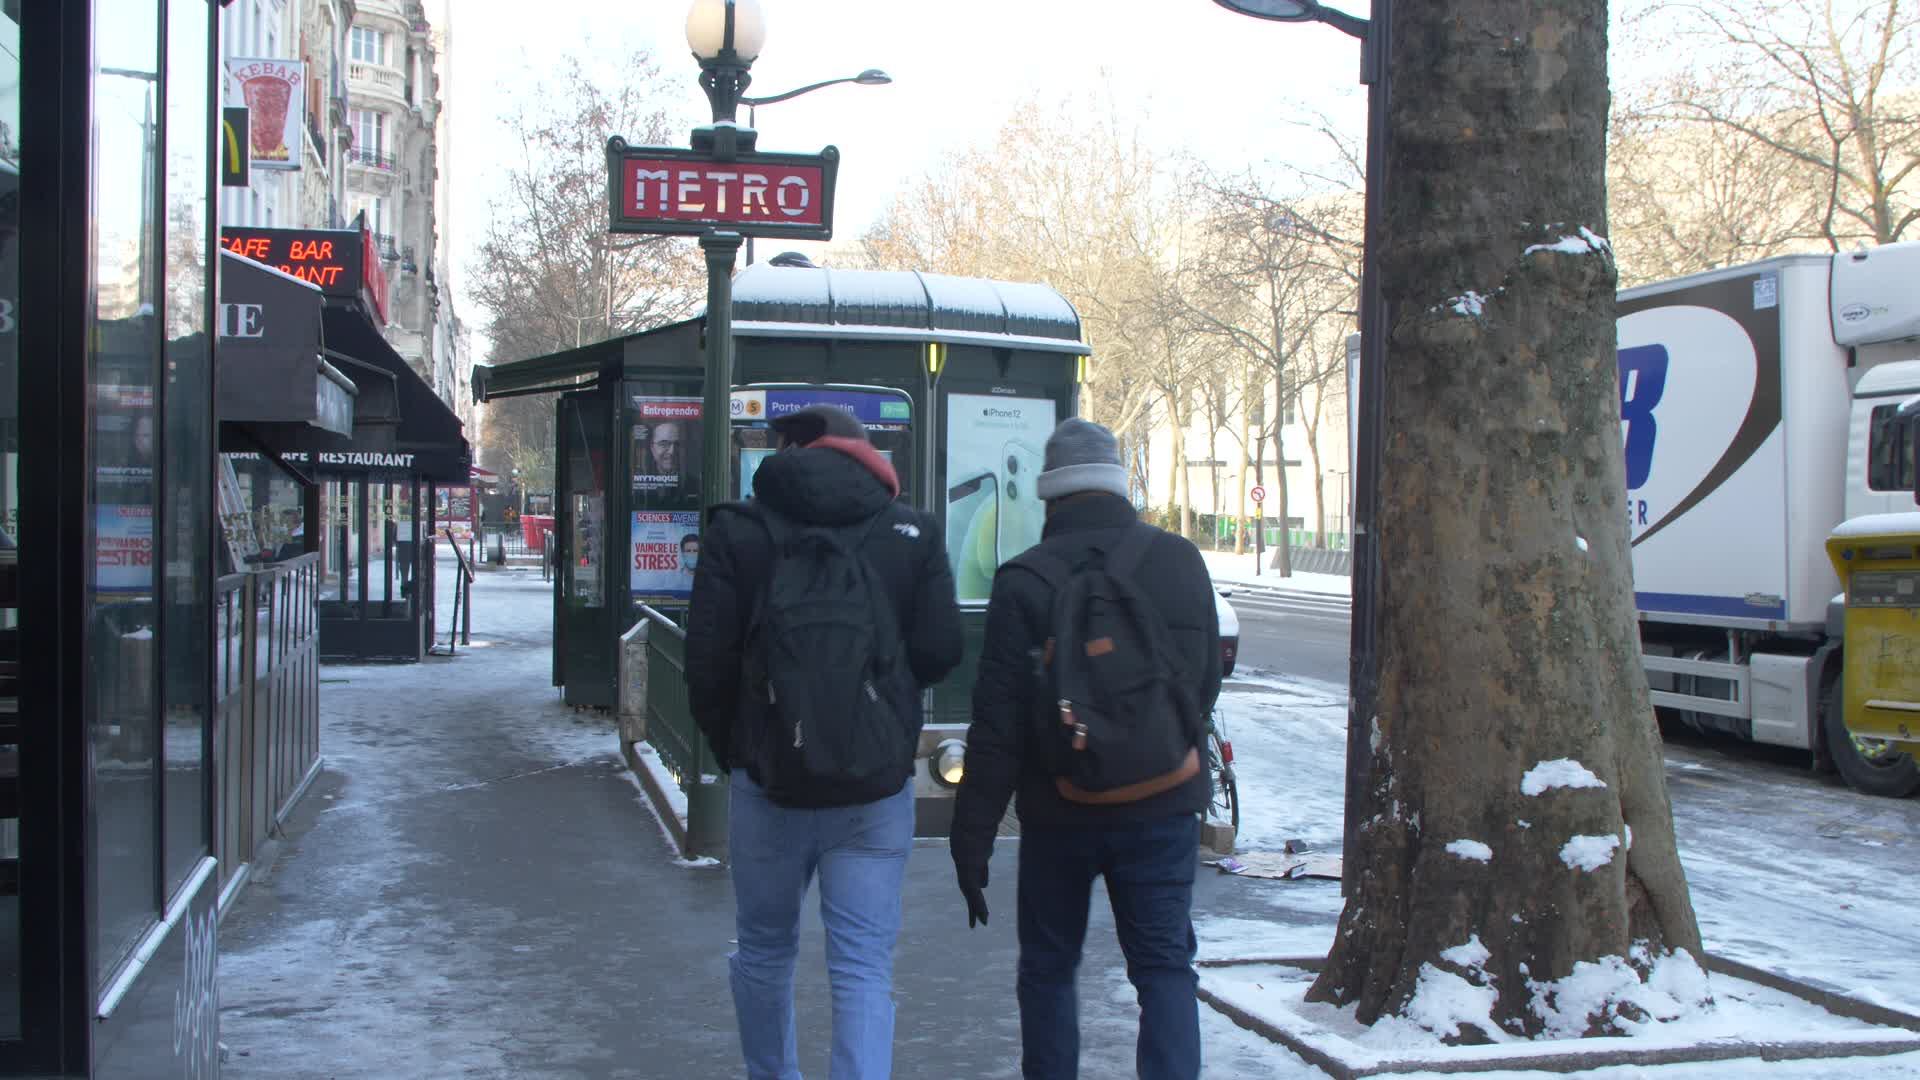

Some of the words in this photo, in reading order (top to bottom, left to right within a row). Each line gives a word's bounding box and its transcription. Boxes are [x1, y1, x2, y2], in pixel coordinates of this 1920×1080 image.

[234, 62, 301, 86] KEBAB
[635, 168, 810, 216] METRO
[221, 238, 272, 258] AFE
[290, 241, 334, 260] BAR
[771, 401, 801, 413] Porte
[988, 407, 1012, 417] iPhone
[318, 452, 414, 467] RESTAURANT
[635, 543, 668, 554] VAINCRE
[634, 554, 678, 570] STRESS
